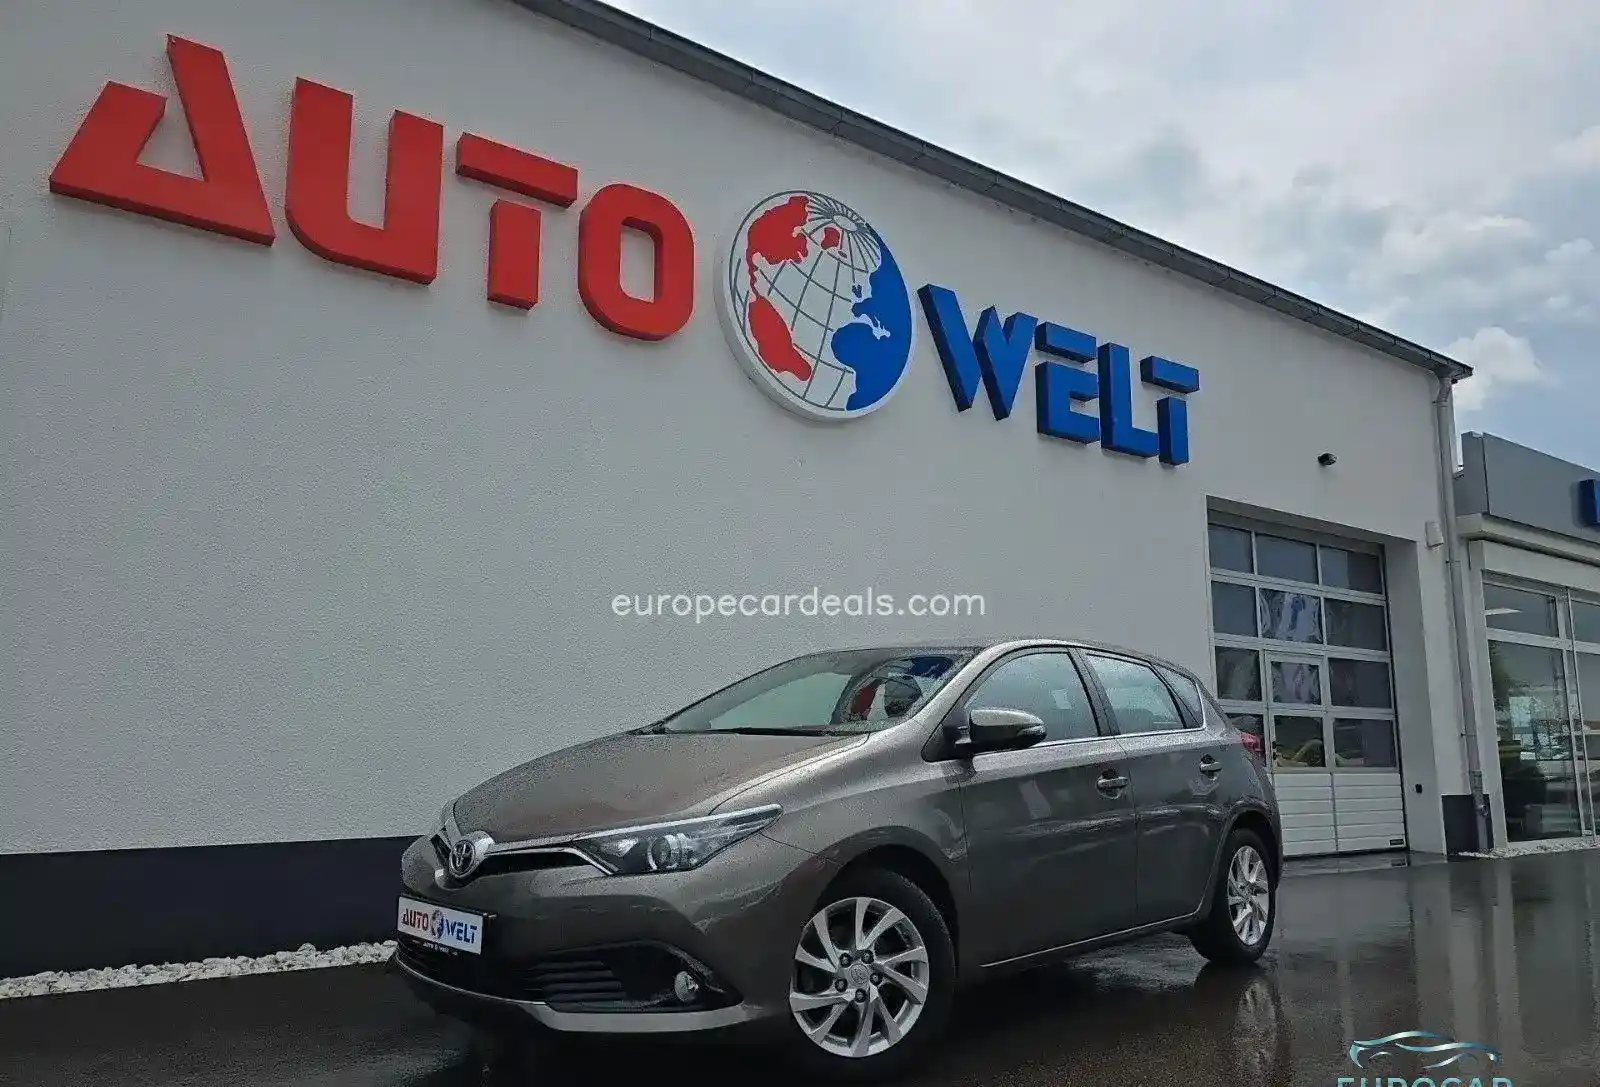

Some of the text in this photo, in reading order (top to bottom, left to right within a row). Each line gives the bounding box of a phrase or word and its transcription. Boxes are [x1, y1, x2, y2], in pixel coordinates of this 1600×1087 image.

[49, 34, 1200, 466] AUTO WELT
[403, 908, 478, 944] AUTO WELT
